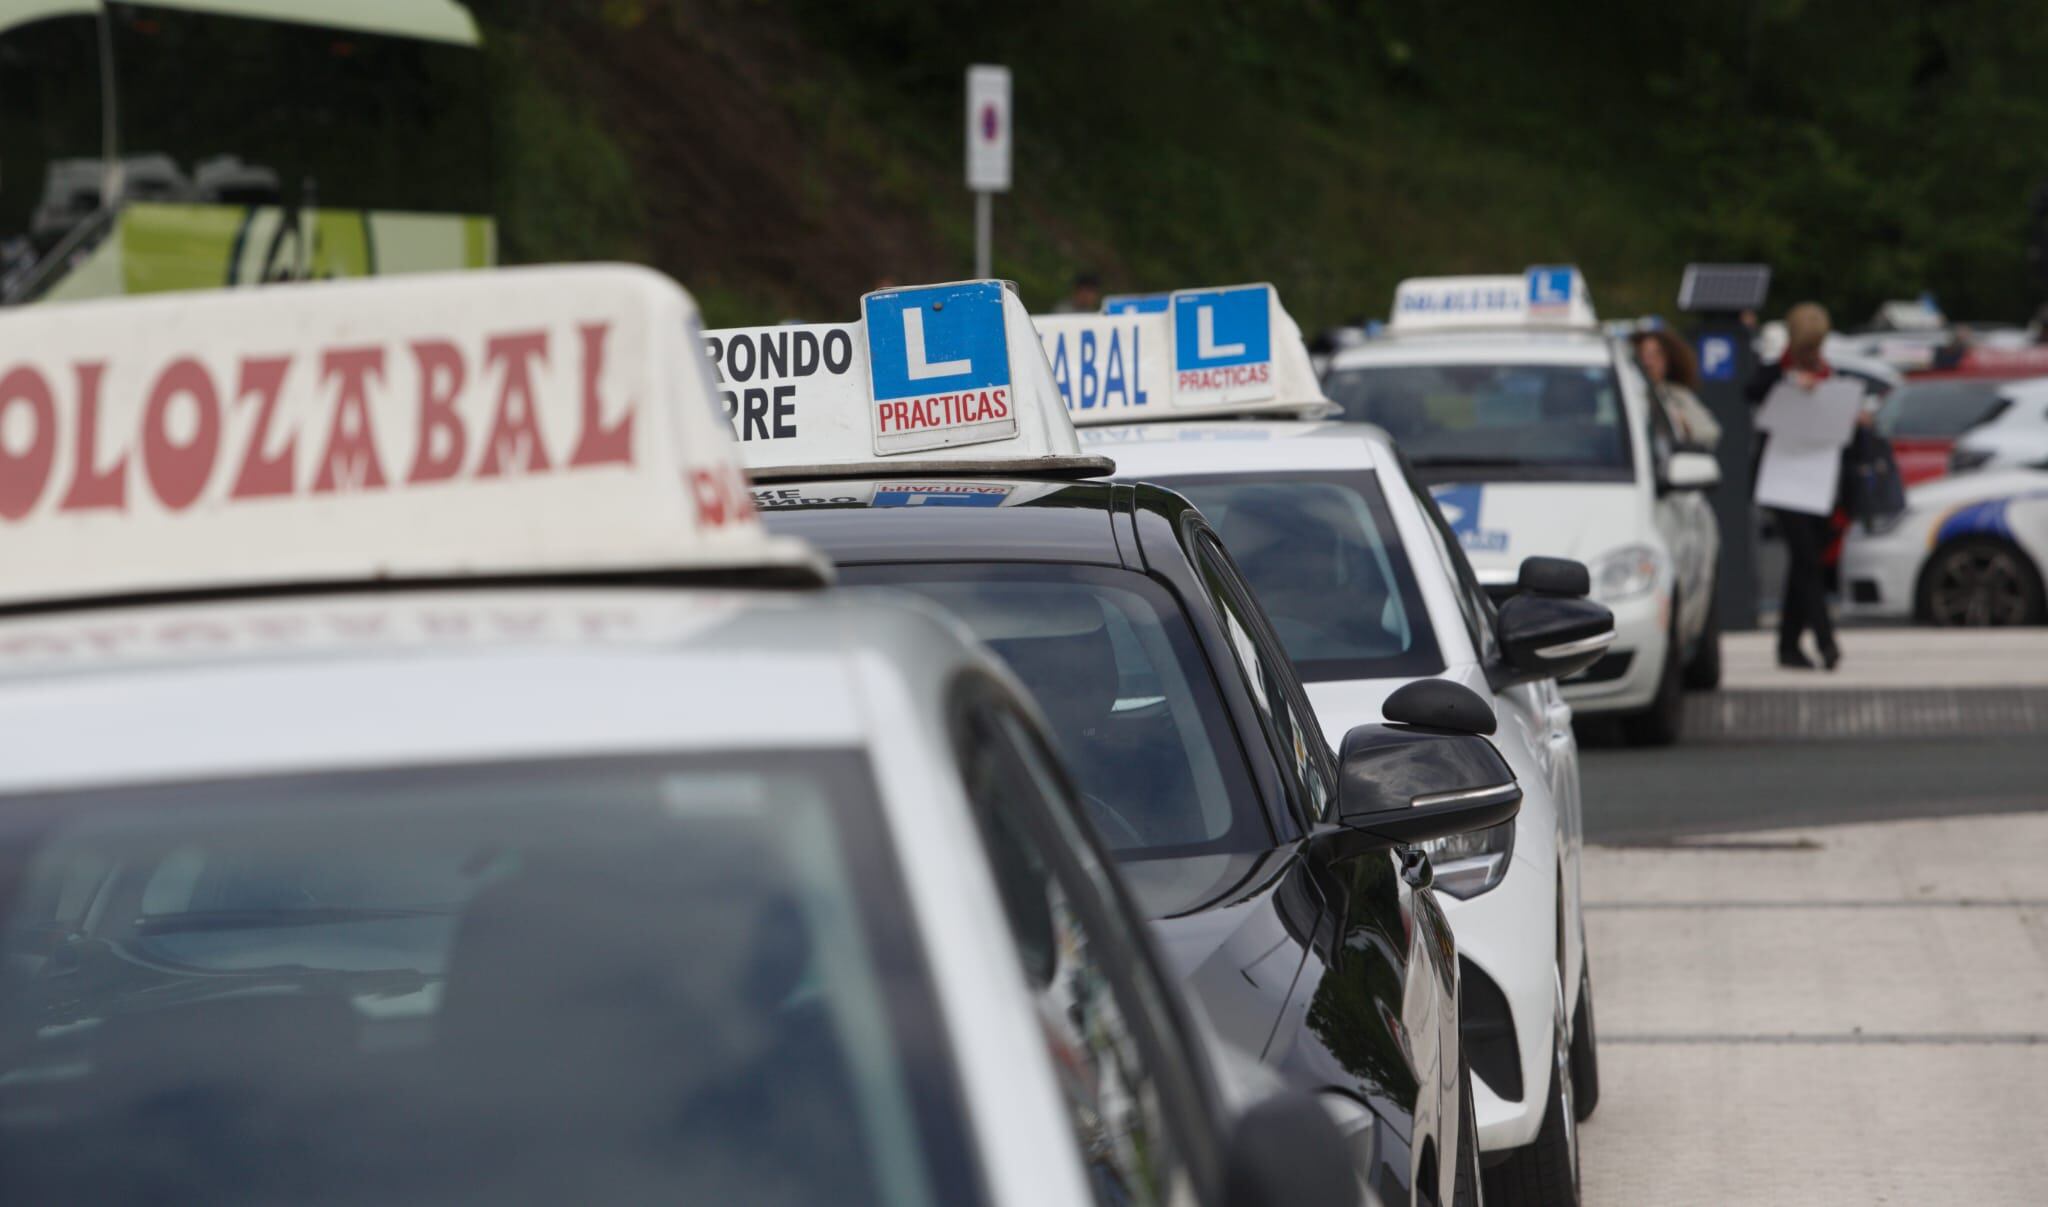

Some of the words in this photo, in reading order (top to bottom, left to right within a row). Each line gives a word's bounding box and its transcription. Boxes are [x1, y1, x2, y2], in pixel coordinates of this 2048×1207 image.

[902, 306, 972, 381] L
[1197, 305, 1246, 359] L
[1179, 364, 1270, 391] PRACTICAS
[879, 389, 1008, 432] PRACTICAS
